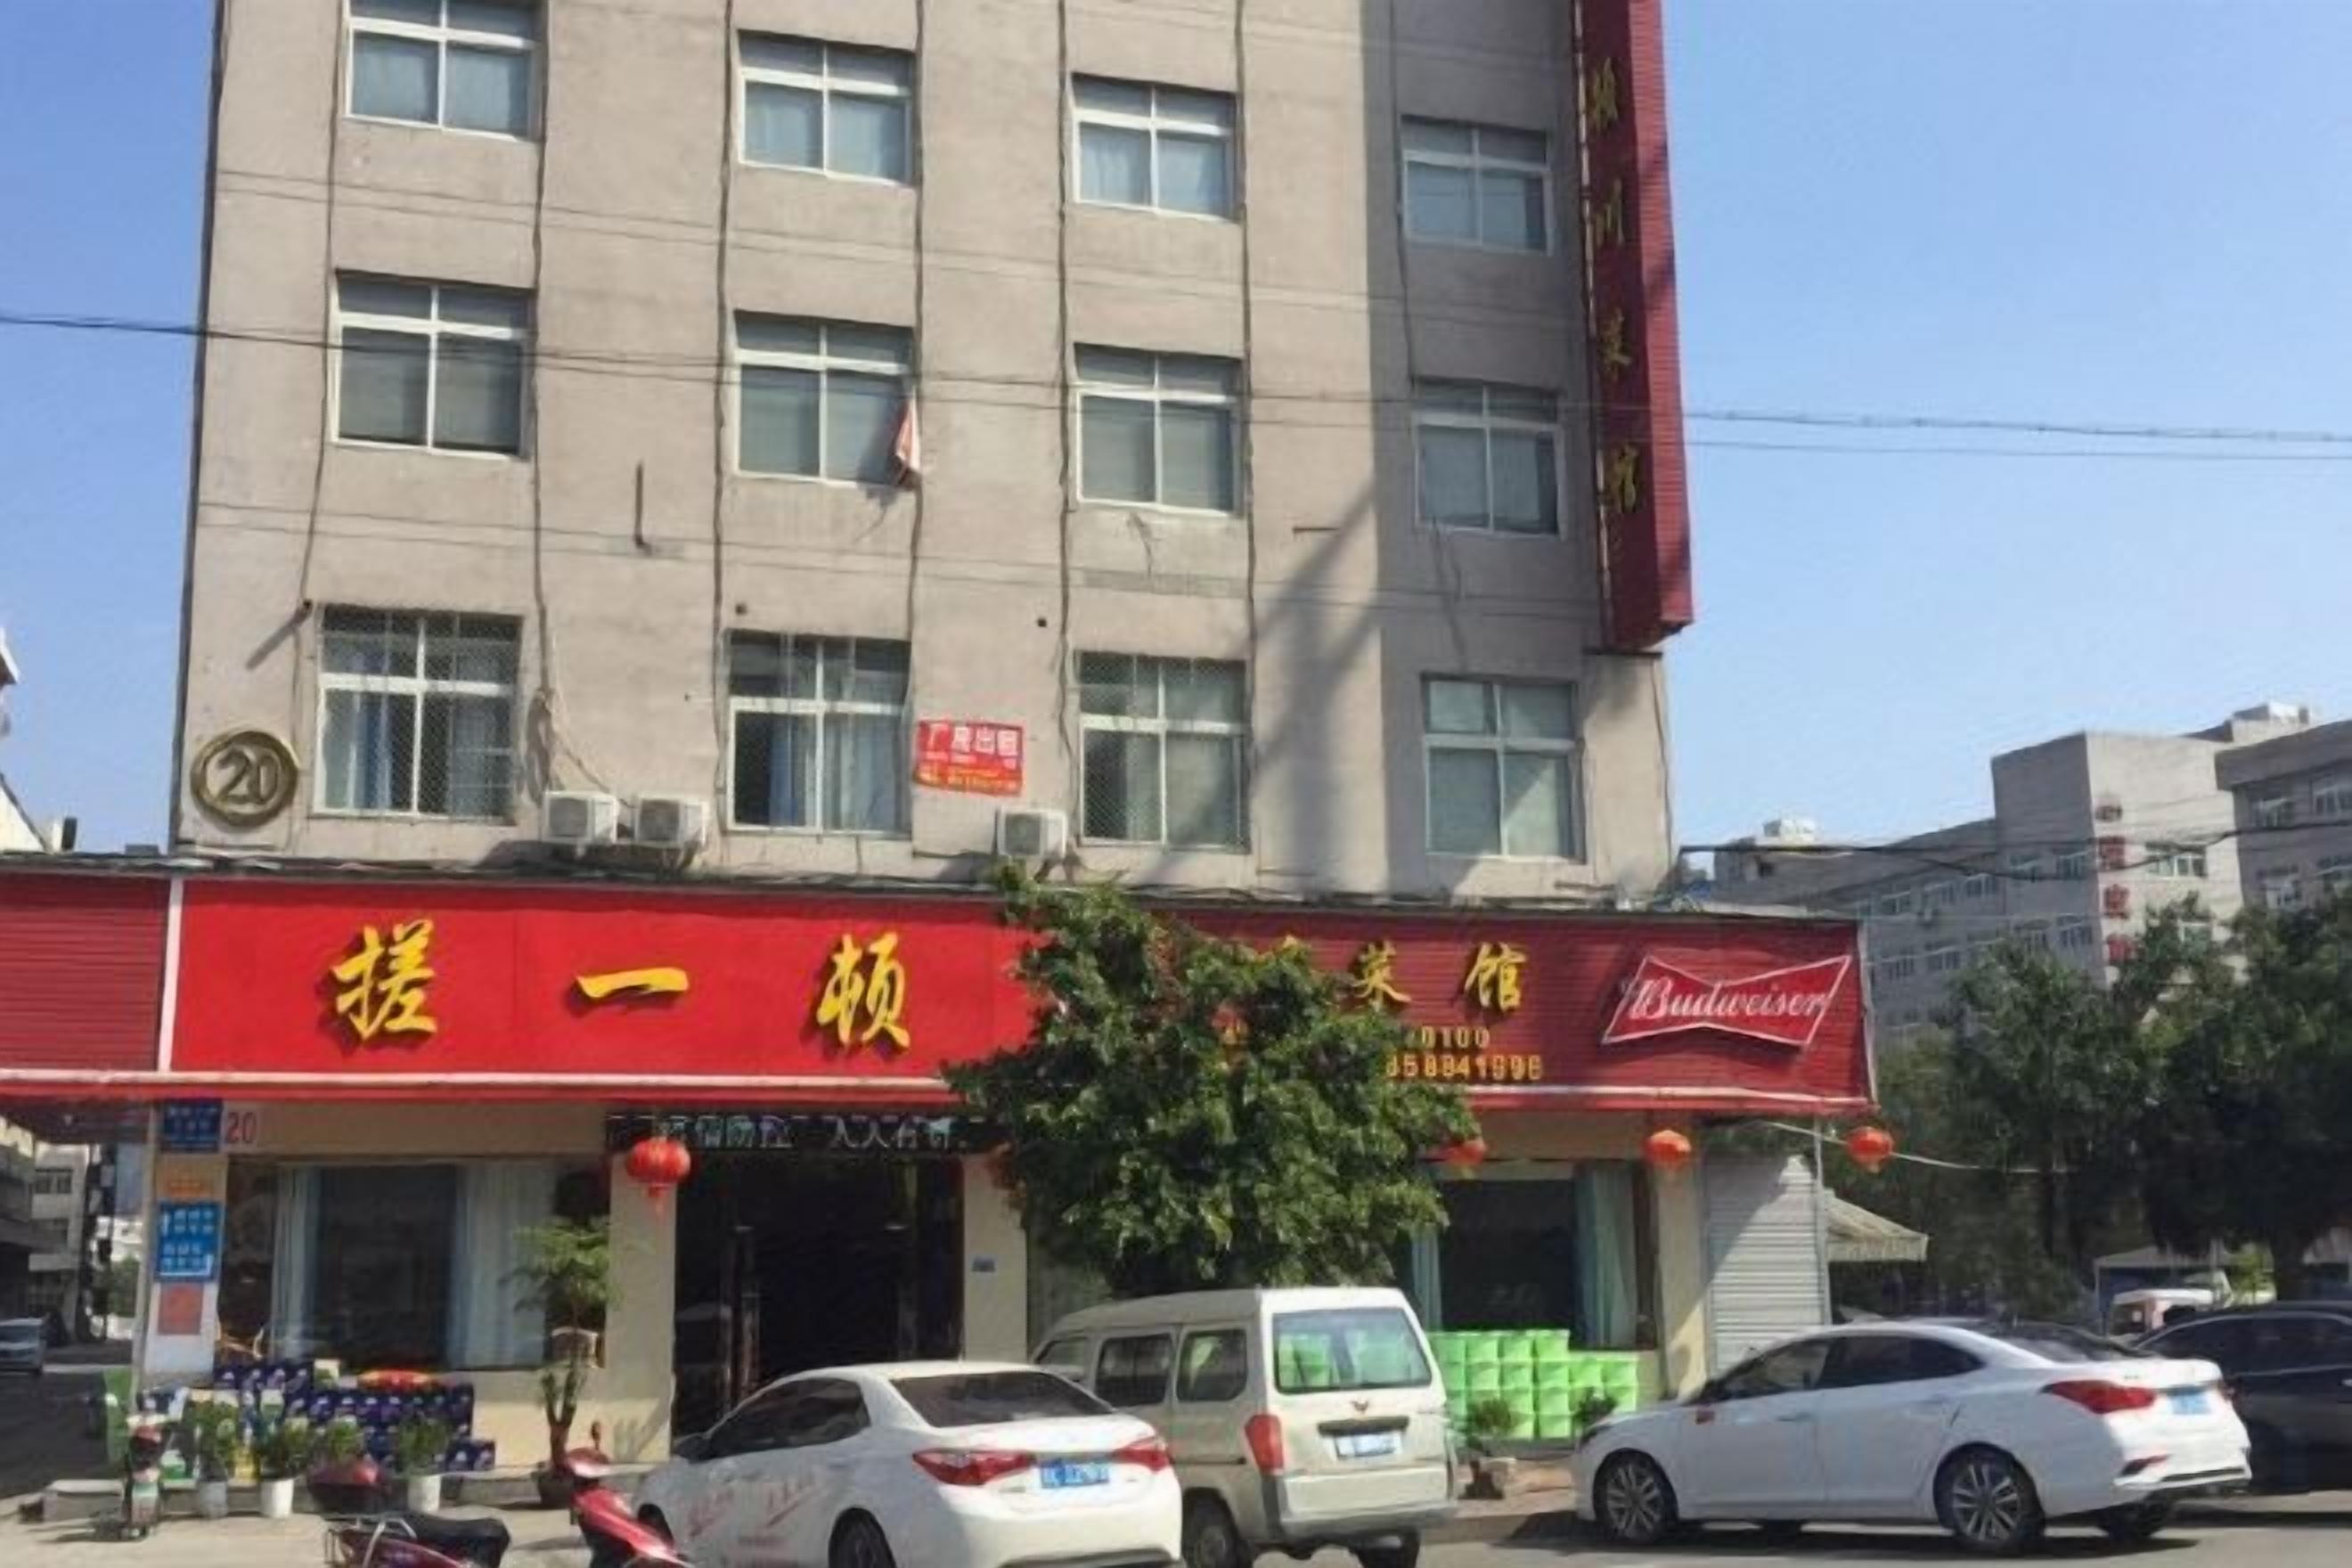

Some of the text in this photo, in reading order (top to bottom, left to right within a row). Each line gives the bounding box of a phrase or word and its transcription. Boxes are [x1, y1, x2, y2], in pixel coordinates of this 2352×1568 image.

[216, 747, 279, 805] 20
[1628, 976, 1827, 1020] Budweiser
[1406, 1026, 1490, 1049] 0100
[226, 1111, 257, 1145] 20
